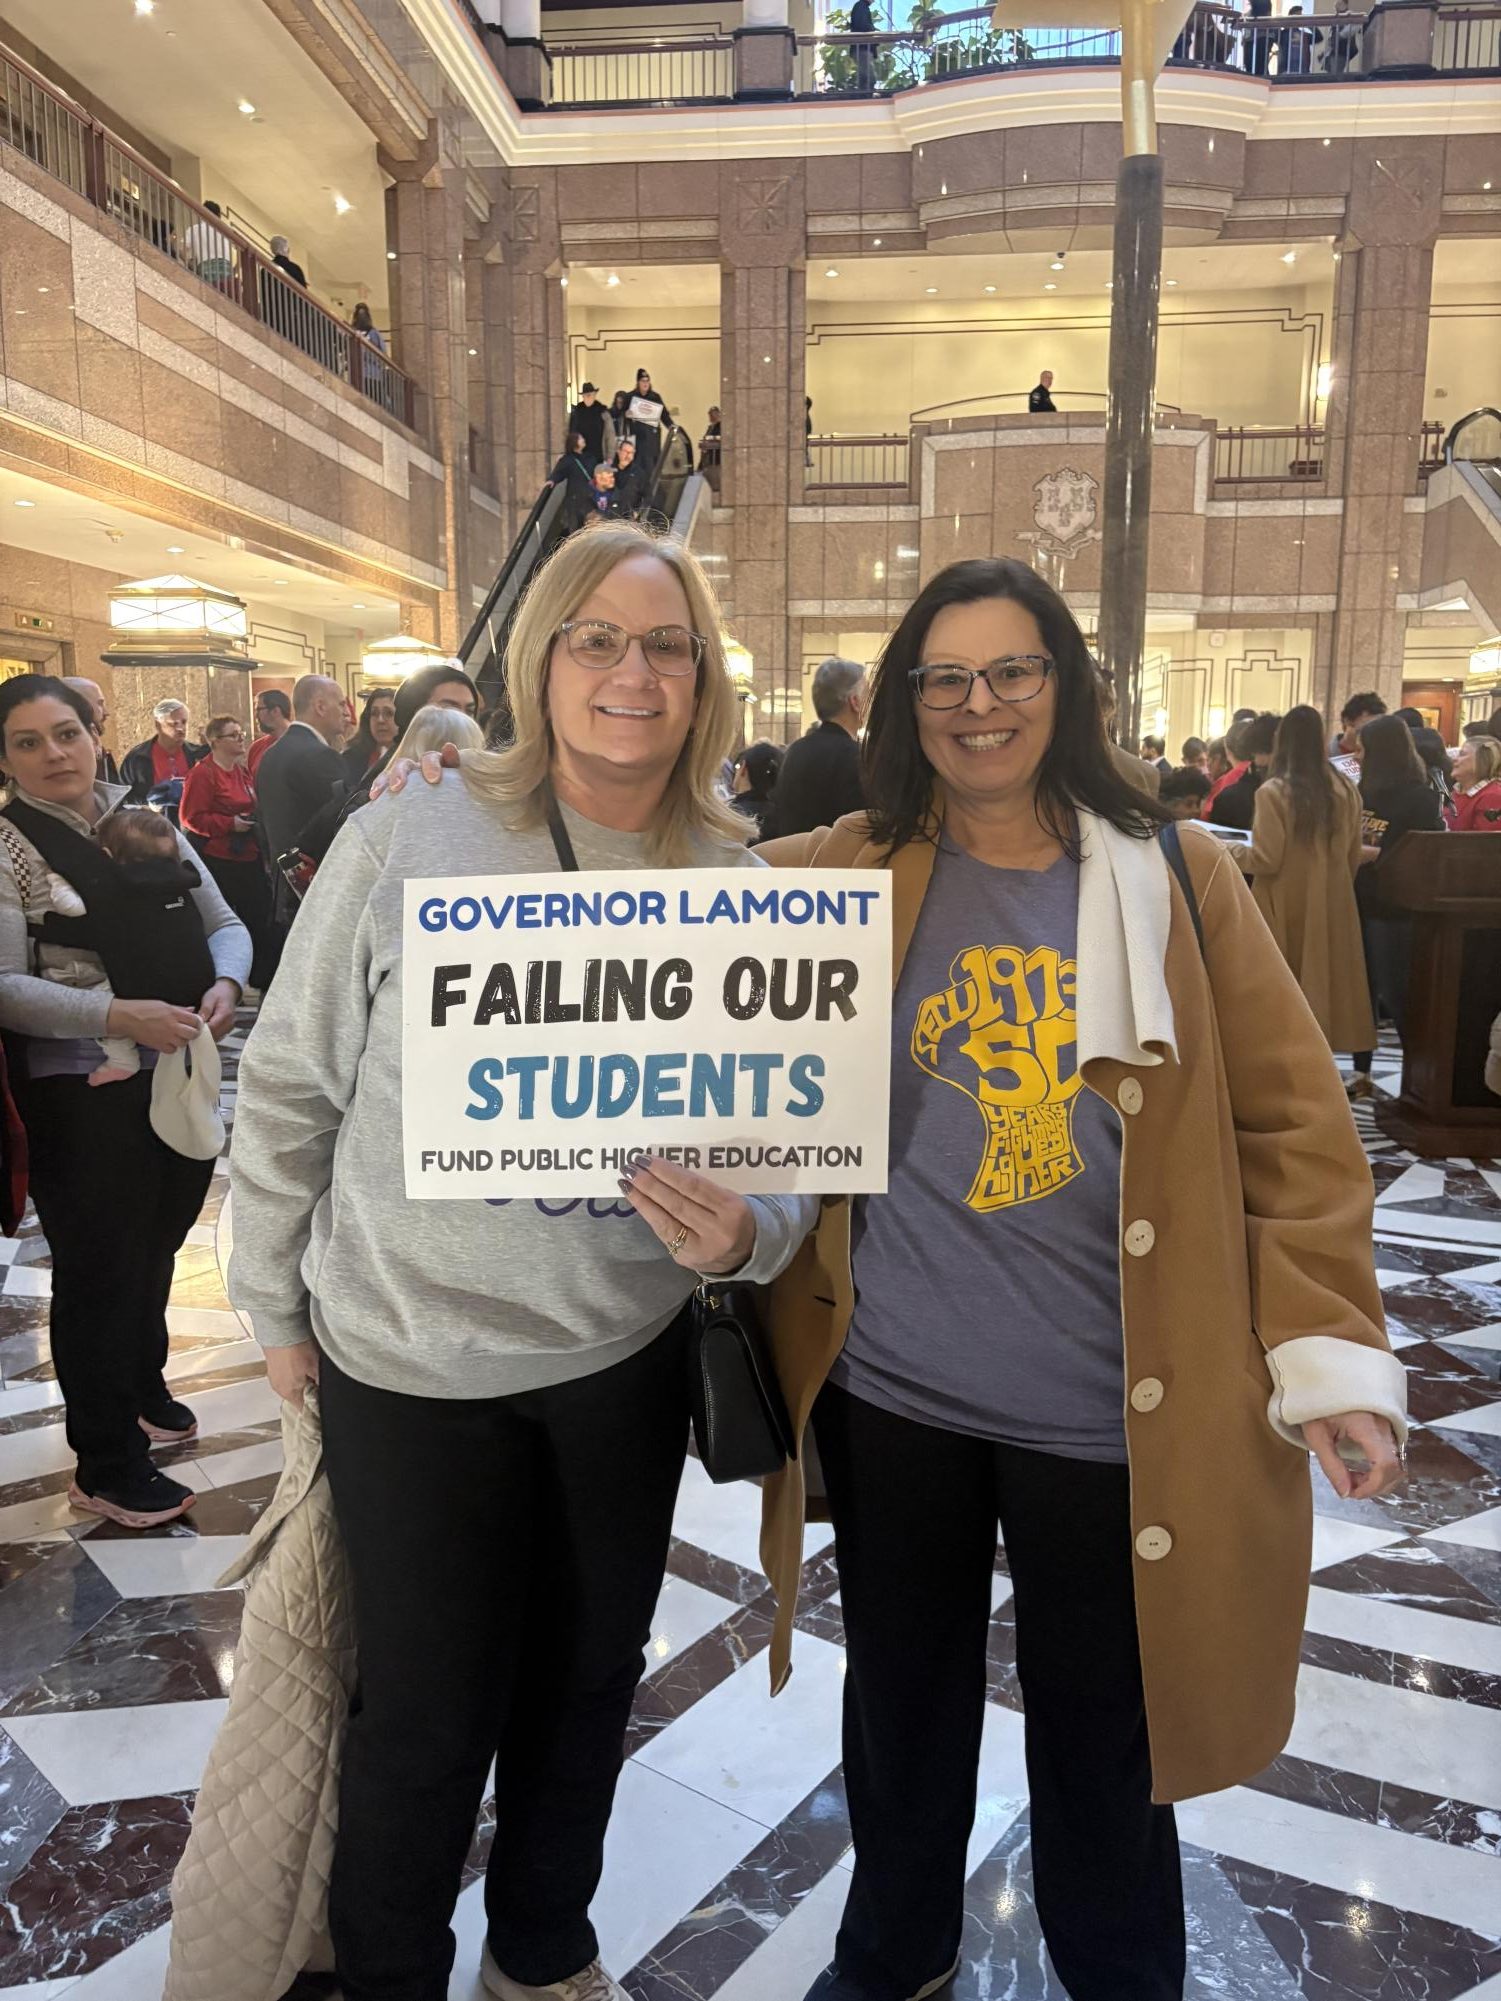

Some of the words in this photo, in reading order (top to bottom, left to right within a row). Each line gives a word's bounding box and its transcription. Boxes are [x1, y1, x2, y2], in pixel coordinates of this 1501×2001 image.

[418, 890, 667, 933] GOVERNOR
[679, 889, 880, 926] LAMONT
[430, 957, 693, 1028] FAILING
[722, 956, 859, 1022] OUR
[465, 1052, 826, 1121] STUDENTS
[421, 1149, 494, 1172] FUND
[500, 1148, 594, 1171] PUBLIC
[601, 1146, 702, 1169] HIGER
[708, 1145, 864, 1169] EDUCATION
